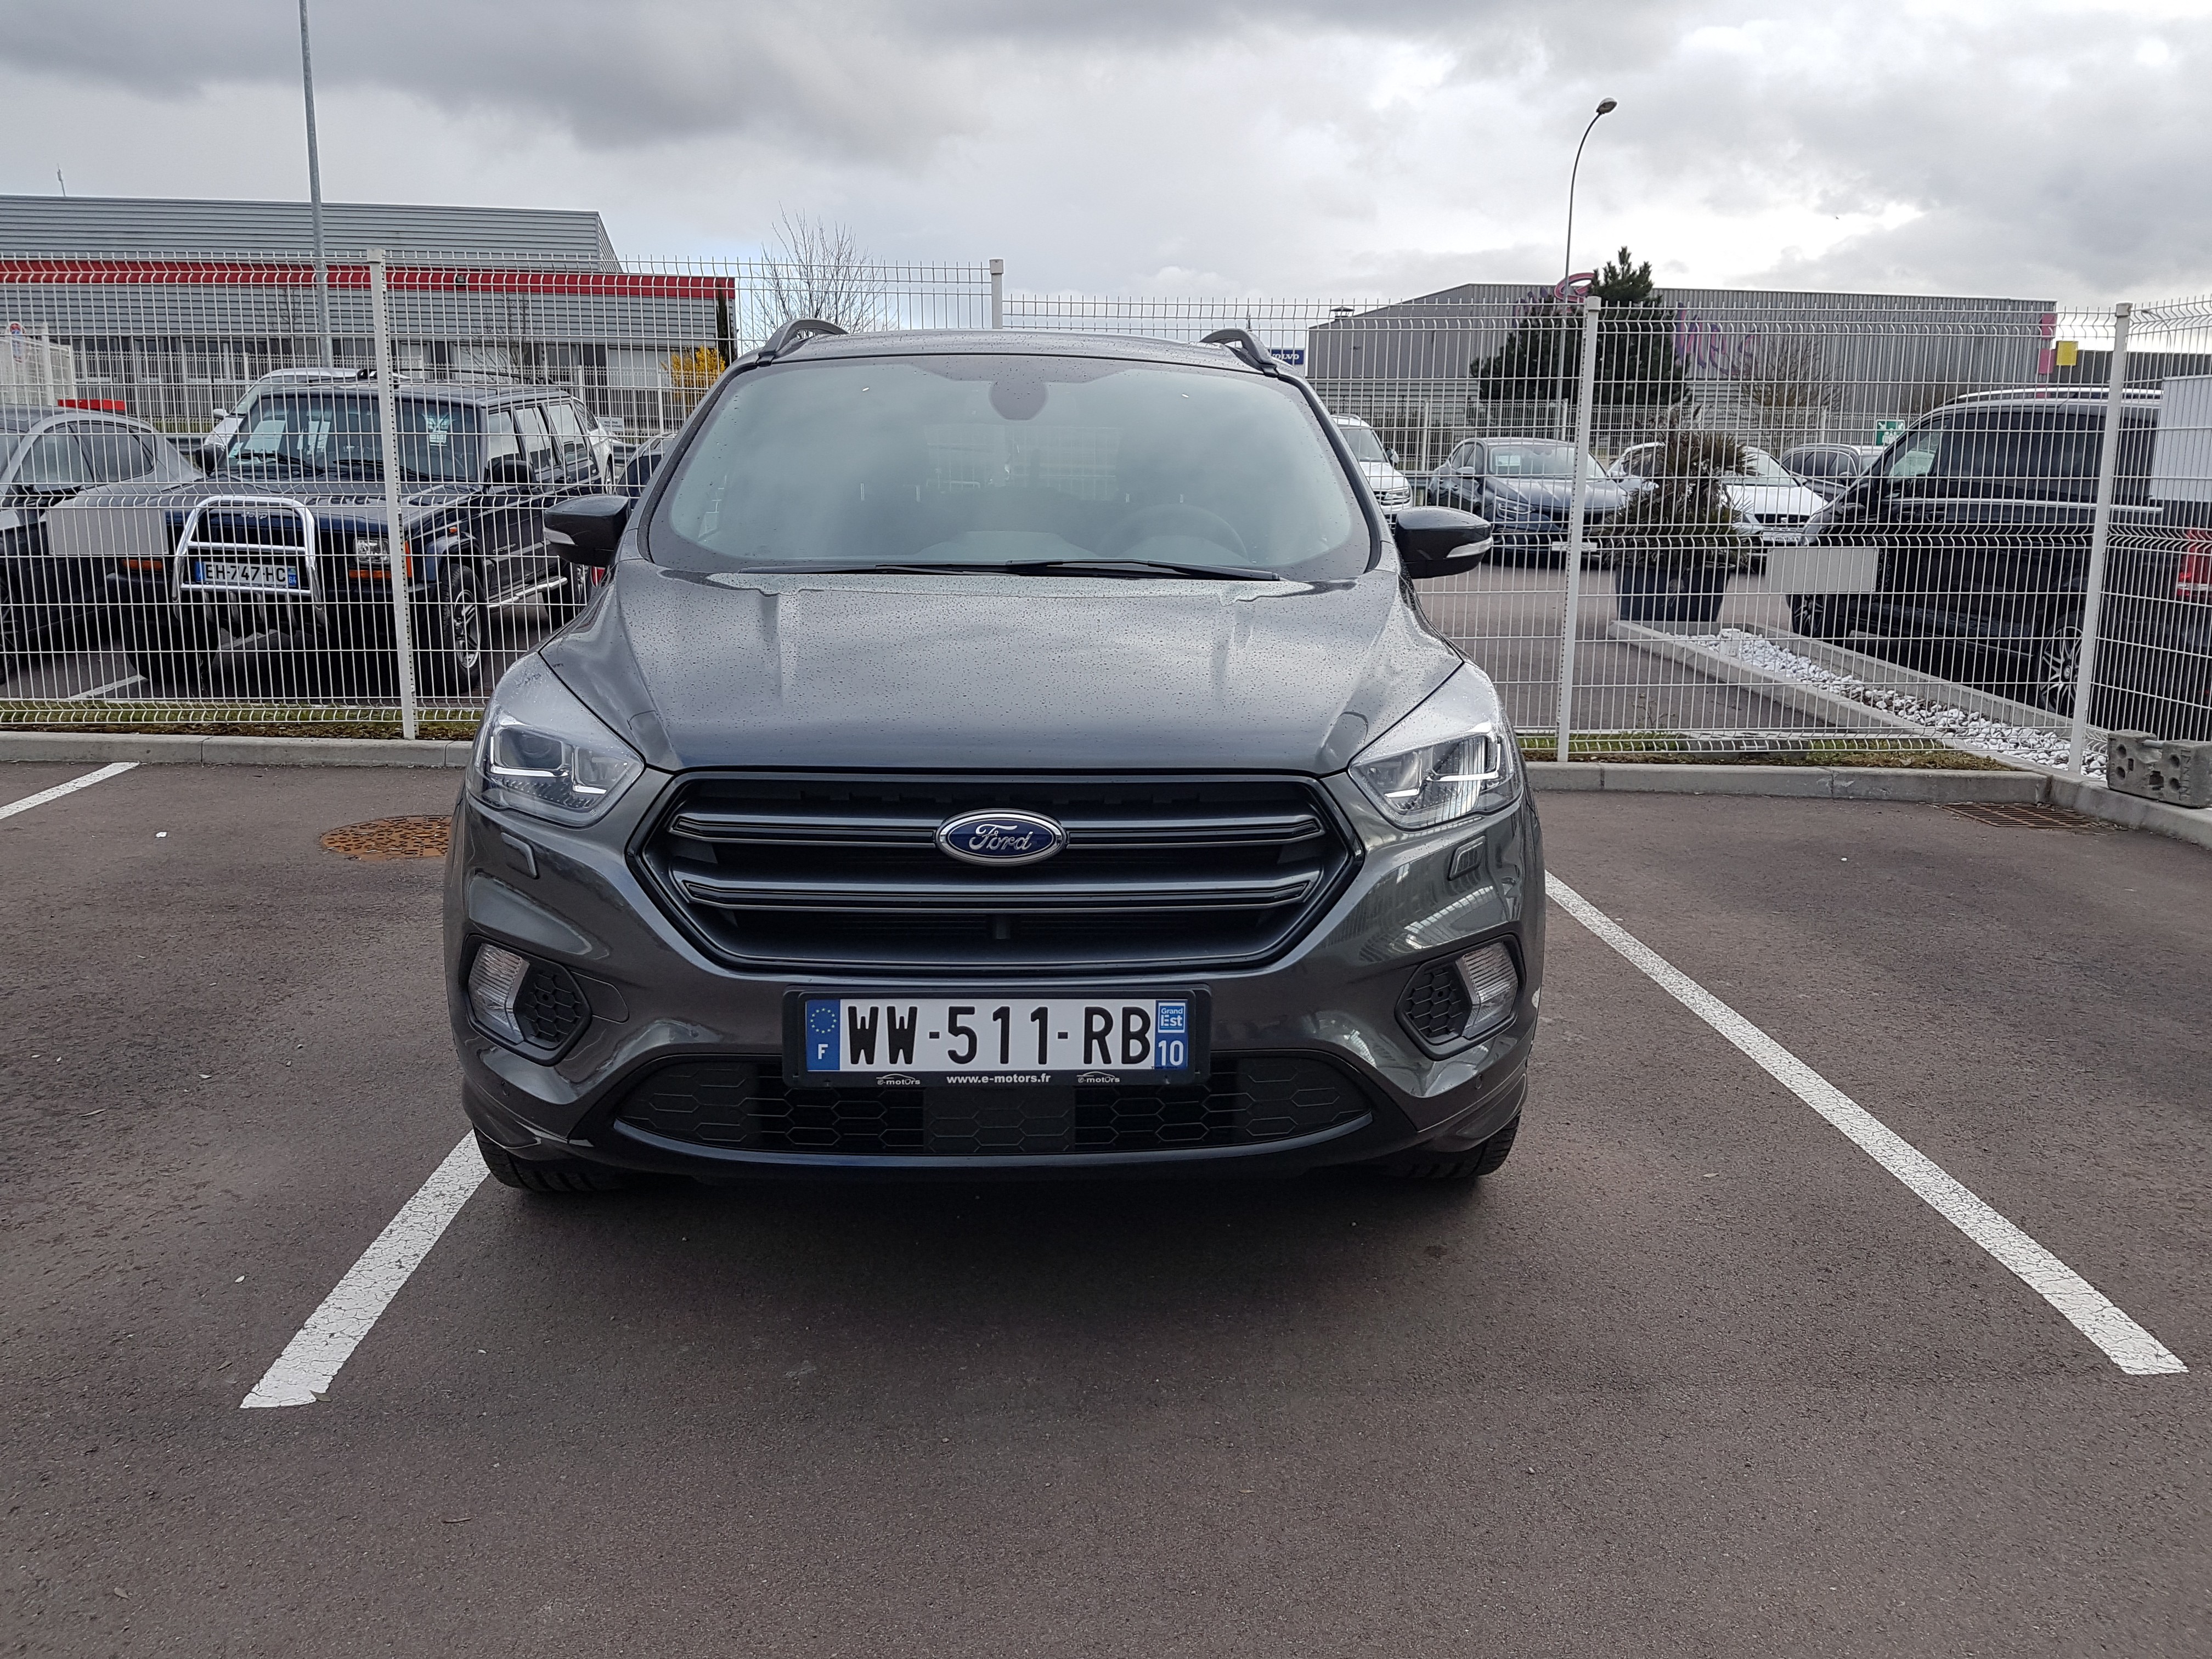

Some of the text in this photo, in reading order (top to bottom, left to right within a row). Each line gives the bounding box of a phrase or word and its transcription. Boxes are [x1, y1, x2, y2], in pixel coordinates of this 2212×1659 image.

[969, 824, 1034, 850] Ford
[1161, 1014, 1182, 1026] Est
[848, 1006, 1151, 1065] WW-511-RB
[818, 1044, 828, 1059] F
[1158, 1040, 1183, 1066] 10
[946, 1073, 1051, 1084] www.e-motors.fr
